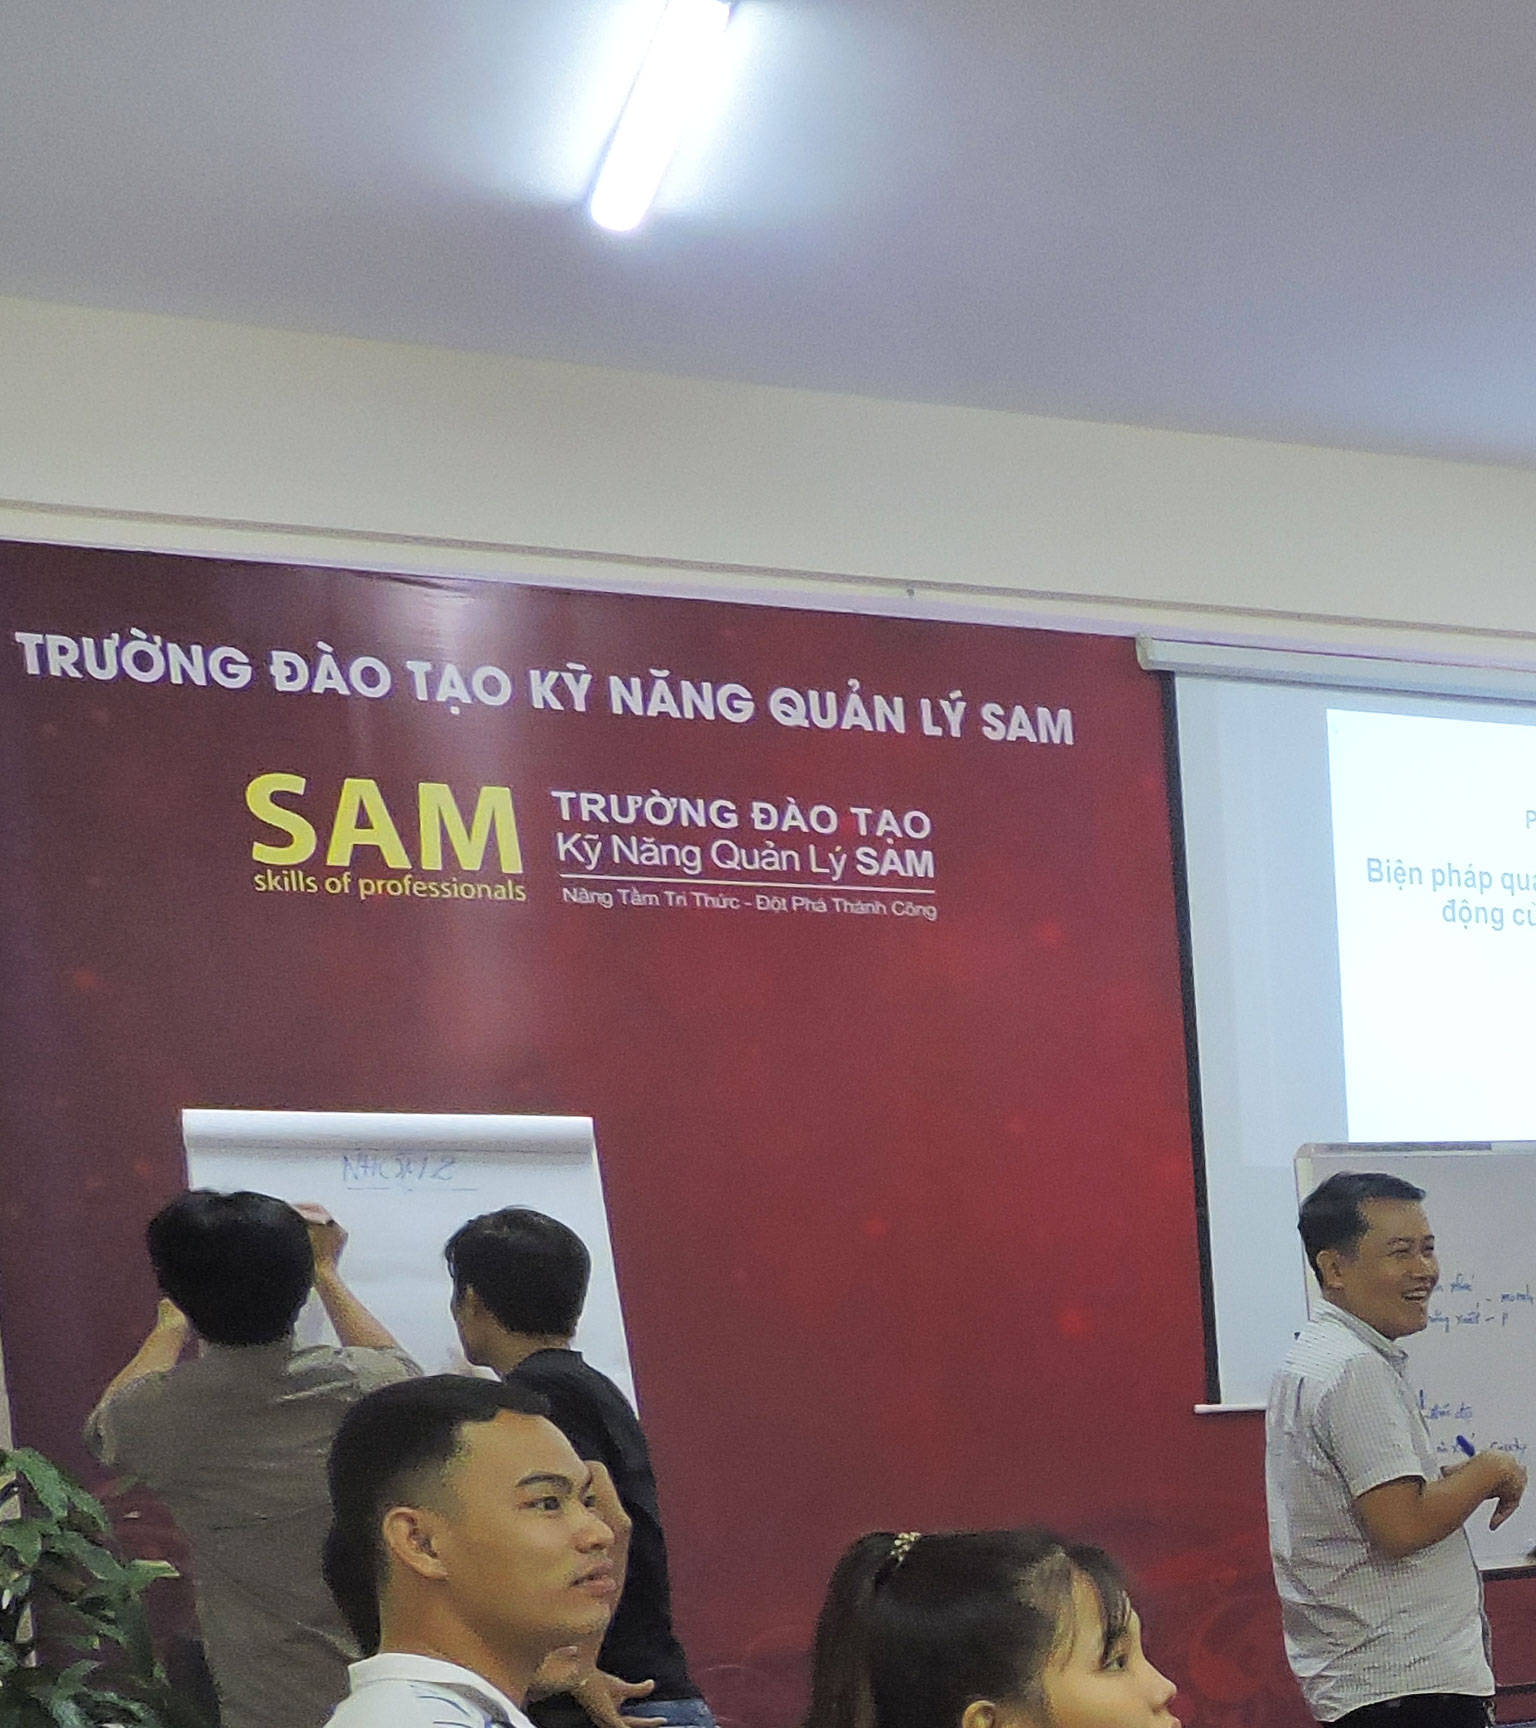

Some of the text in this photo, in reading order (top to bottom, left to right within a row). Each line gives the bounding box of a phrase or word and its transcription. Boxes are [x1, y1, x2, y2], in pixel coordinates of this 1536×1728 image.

[14, 627, 1075, 746] TRƯỜNG ĐÀO TẠO KỸ NĂNG QUẢN LÝ SAM
[245, 772, 524, 874] SAM
[550, 788, 932, 845] TRƯỜNG ĐÀO TẠO
[556, 832, 935, 882] Kỹ Năng Quản Lý SAM
[1367, 857, 1423, 891] Biện
[1431, 862, 1493, 895] pháp
[253, 868, 528, 903] skills of professionals
[1442, 898, 1504, 932] động
